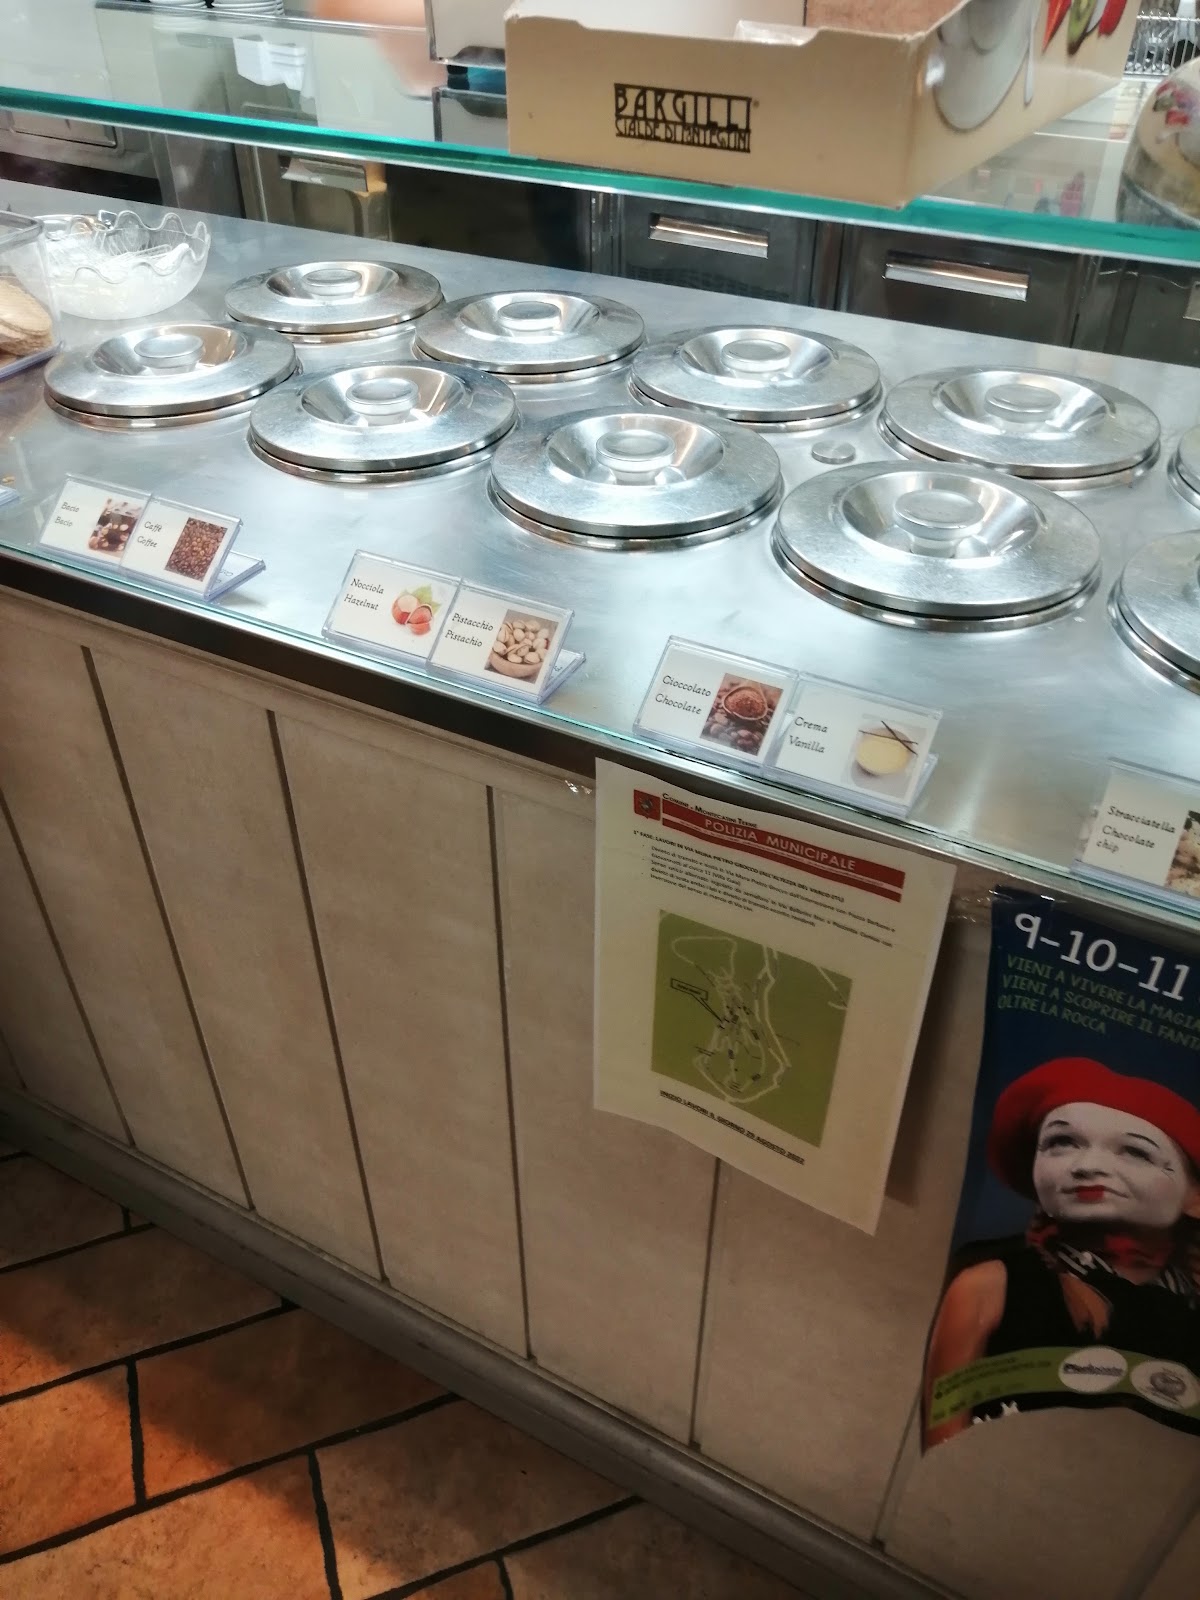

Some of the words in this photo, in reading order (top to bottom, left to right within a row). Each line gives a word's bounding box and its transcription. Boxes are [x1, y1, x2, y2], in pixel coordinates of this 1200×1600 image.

[614, 83, 752, 131] BARGILLI
[61, 502, 80, 513] Bacio
[54, 516, 73, 527] Bacio
[137, 535, 158, 548] Coffee
[350, 578, 385, 594] Nocciola
[343, 593, 379, 611] Hazelnut
[451, 612, 494, 631] Pistacchio
[444, 629, 483, 648] Pistachio
[662, 675, 711, 697] Cioccolato
[655, 693, 702, 715] Chocolate
[794, 716, 828, 733] Crema
[788, 735, 825, 754] Vanilla
[705, 819, 758, 841] POLIZIA
[766, 836, 856, 870] MUNICIPALE
[1102, 825, 1155, 848] Chocolate
[1096, 839, 1119, 854] chip
[1015, 913, 1190, 1000] 9-10-11
[1007, 953, 1052, 979] VIENI
[1054, 970, 1066, 983] A
[1071, 973, 1127, 1003] VIVERE
[1128, 995, 1147, 1012] LA
[1002, 974, 1048, 995] VIENI
[1051, 987, 1060, 1000] A
[1064, 991, 1137, 1027] SCOPRIRE
[1138, 1018, 1153, 1034] IL
[997, 995, 1037, 1011] OLTRE
[1040, 1002, 1058, 1017] LA
[1061, 1007, 1107, 1034] ROCCA
